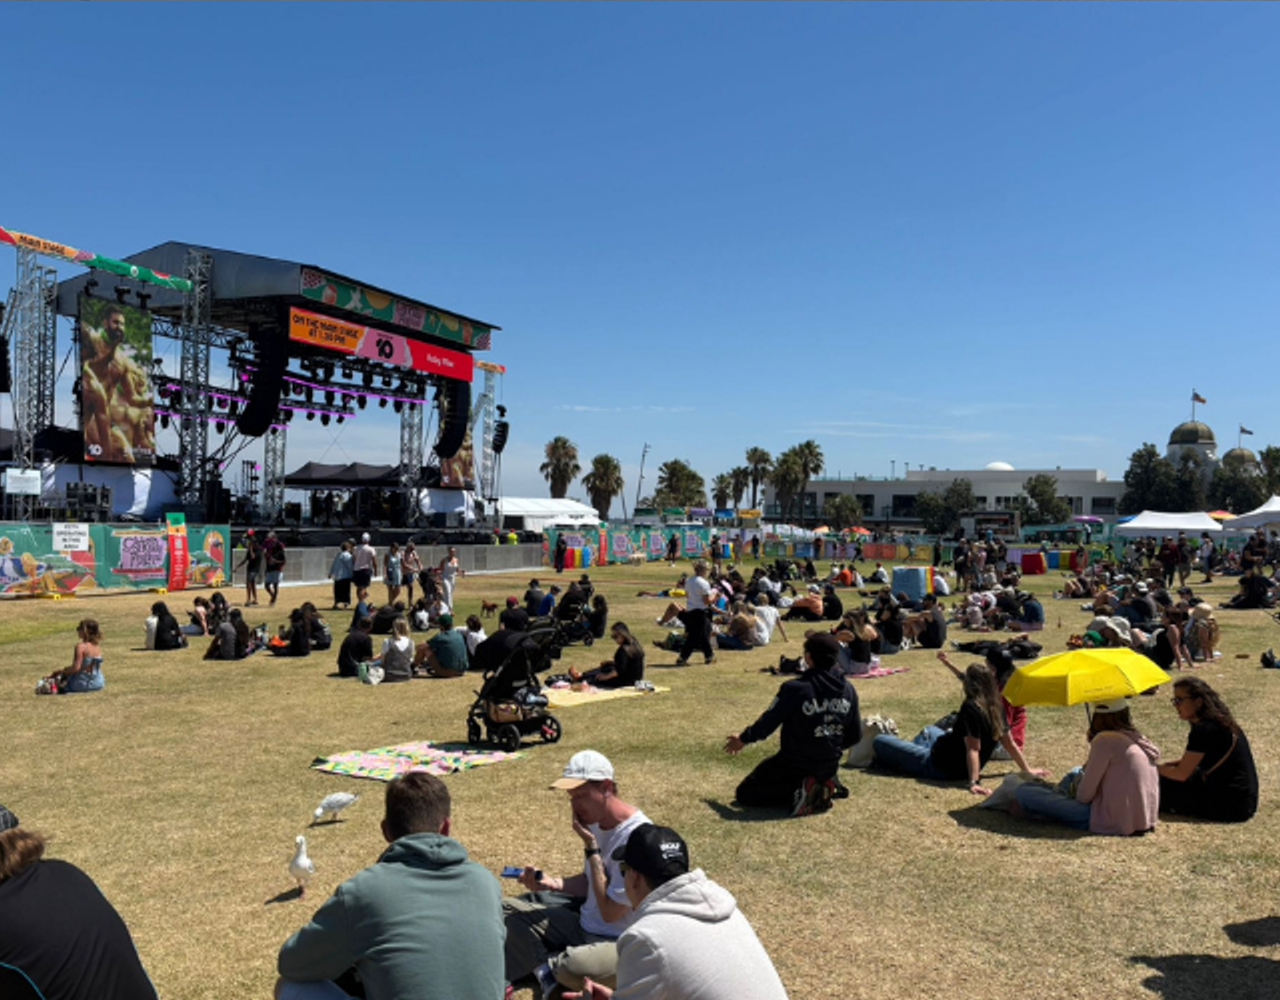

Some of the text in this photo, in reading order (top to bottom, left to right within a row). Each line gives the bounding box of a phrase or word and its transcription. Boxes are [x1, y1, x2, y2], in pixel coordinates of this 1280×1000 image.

[292, 314, 304, 324] ON
[305, 317, 320, 328] THE
[376, 338, 394, 359] 10
